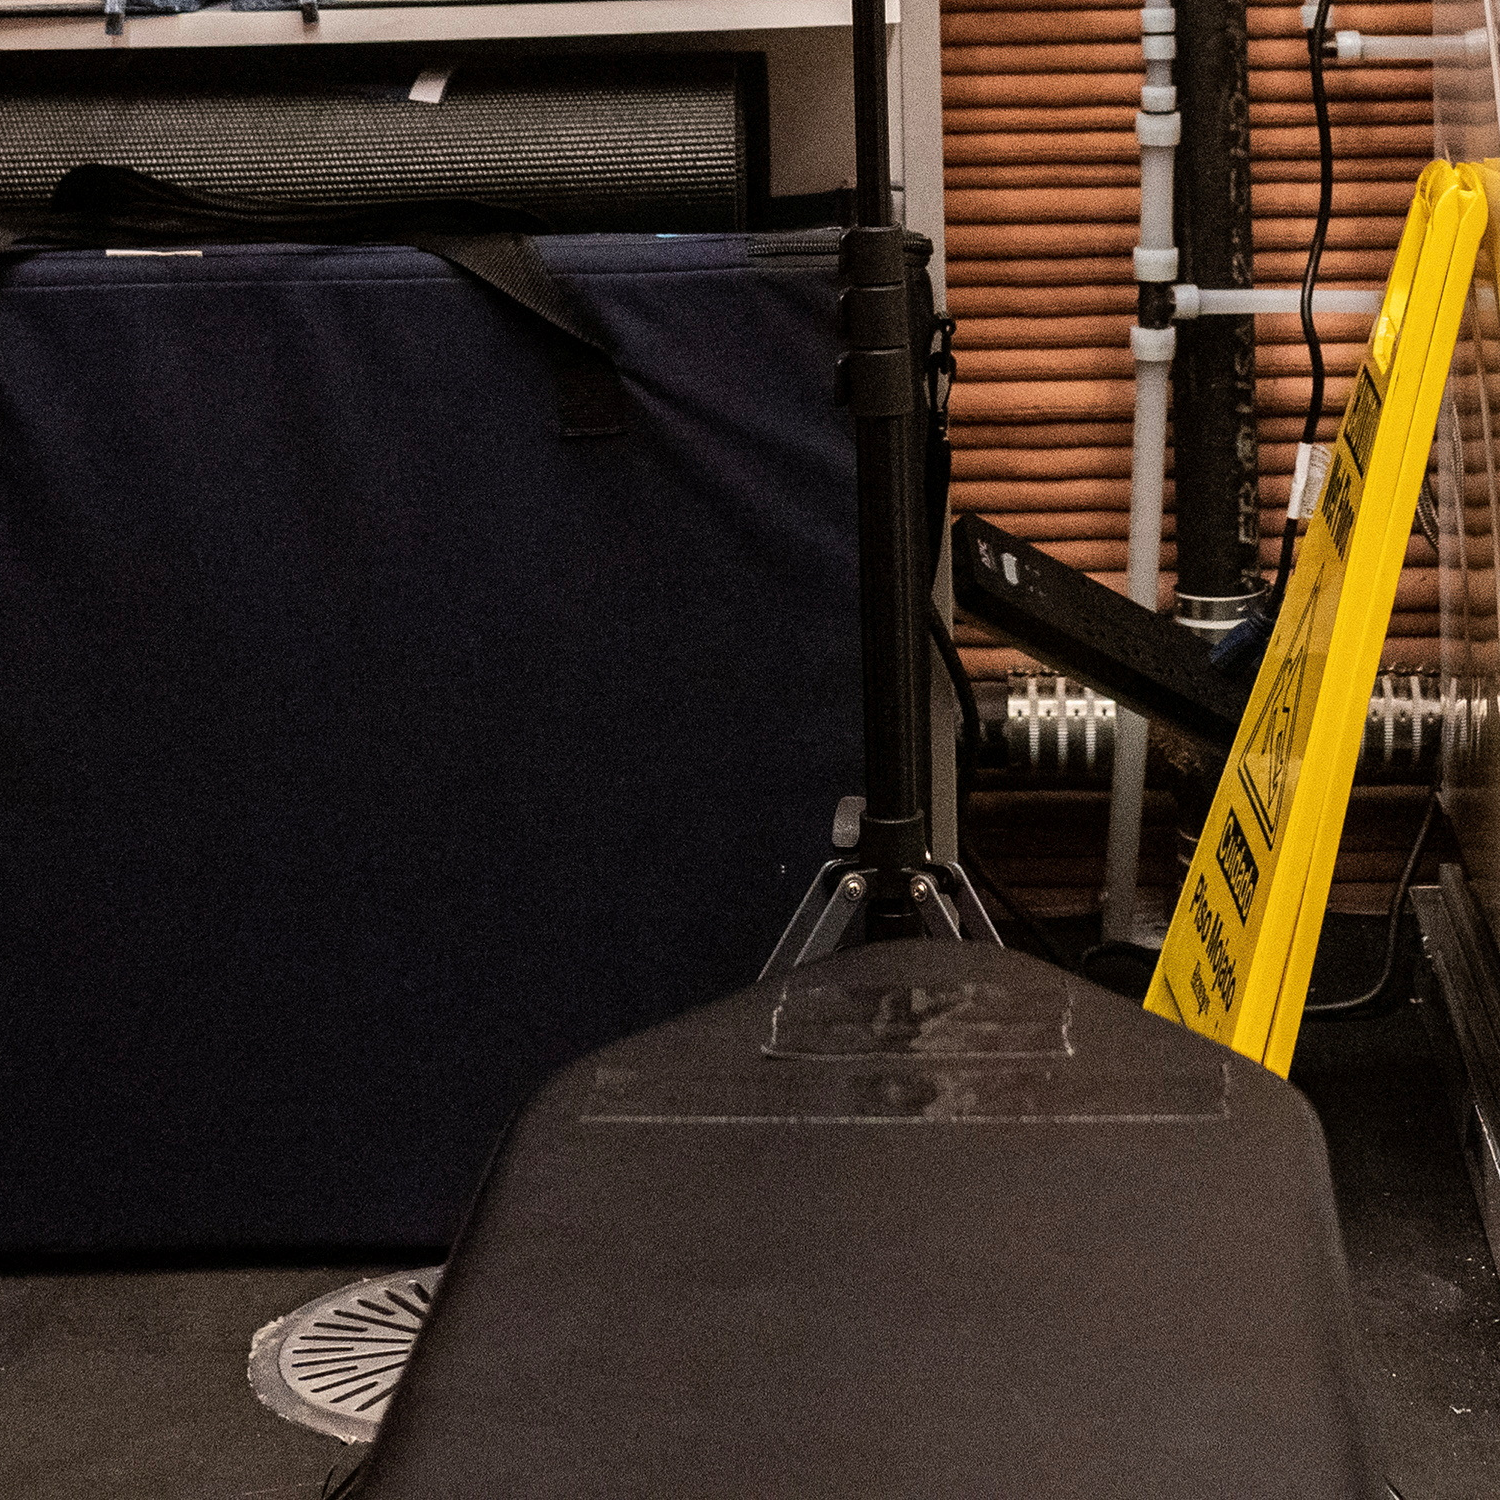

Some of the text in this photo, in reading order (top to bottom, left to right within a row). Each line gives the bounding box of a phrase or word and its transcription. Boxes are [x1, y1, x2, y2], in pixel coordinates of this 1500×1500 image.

[1219, 815, 1255, 918] Cuidado
[1189, 873, 1212, 944] Piso
[1205, 912, 1237, 1013] Mojado
